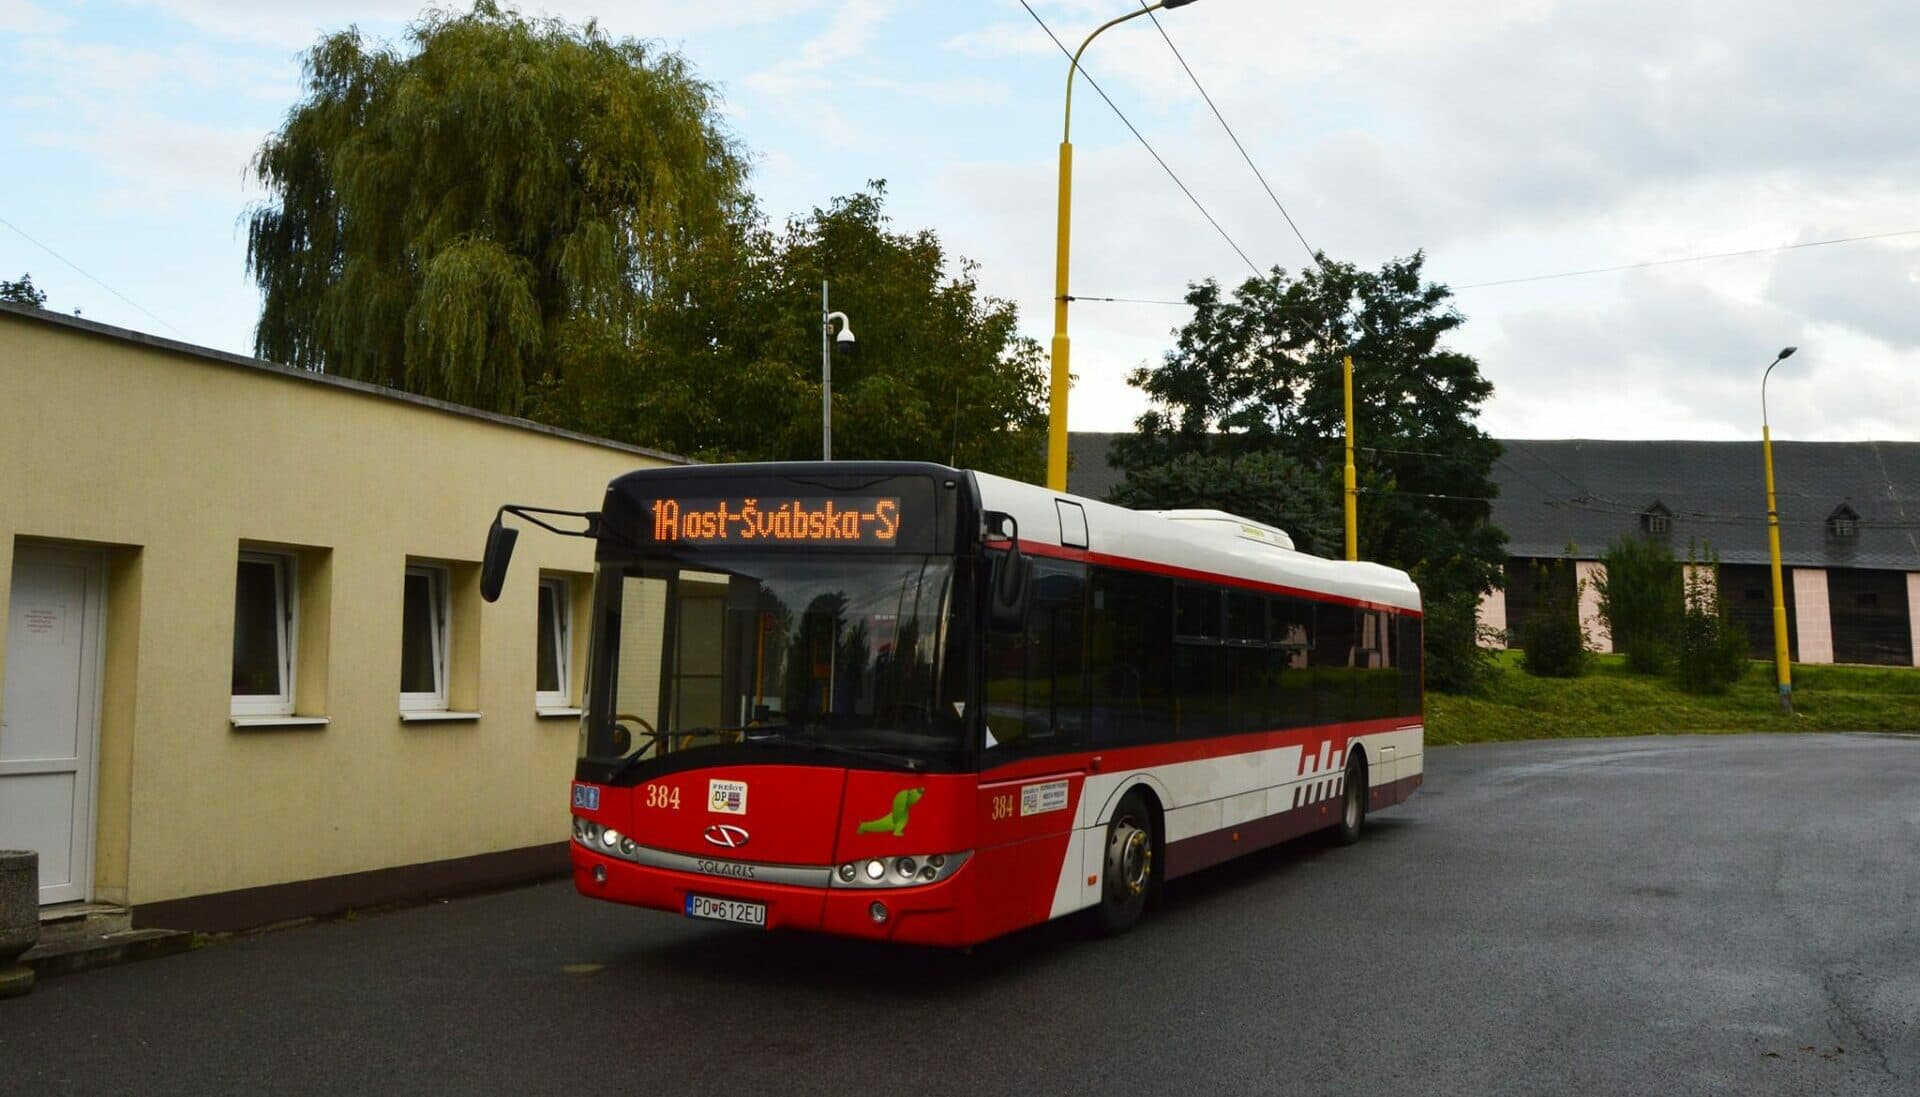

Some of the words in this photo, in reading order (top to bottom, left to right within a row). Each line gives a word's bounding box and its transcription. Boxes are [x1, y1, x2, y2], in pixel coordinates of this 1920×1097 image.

[652, 499, 679, 540] 1A
[682, 499, 900, 539] ost-Švábska-S
[646, 784, 681, 810] 384
[714, 790, 728, 802] DP
[991, 794, 1014, 820] 384
[696, 860, 755, 879] SOLARIS
